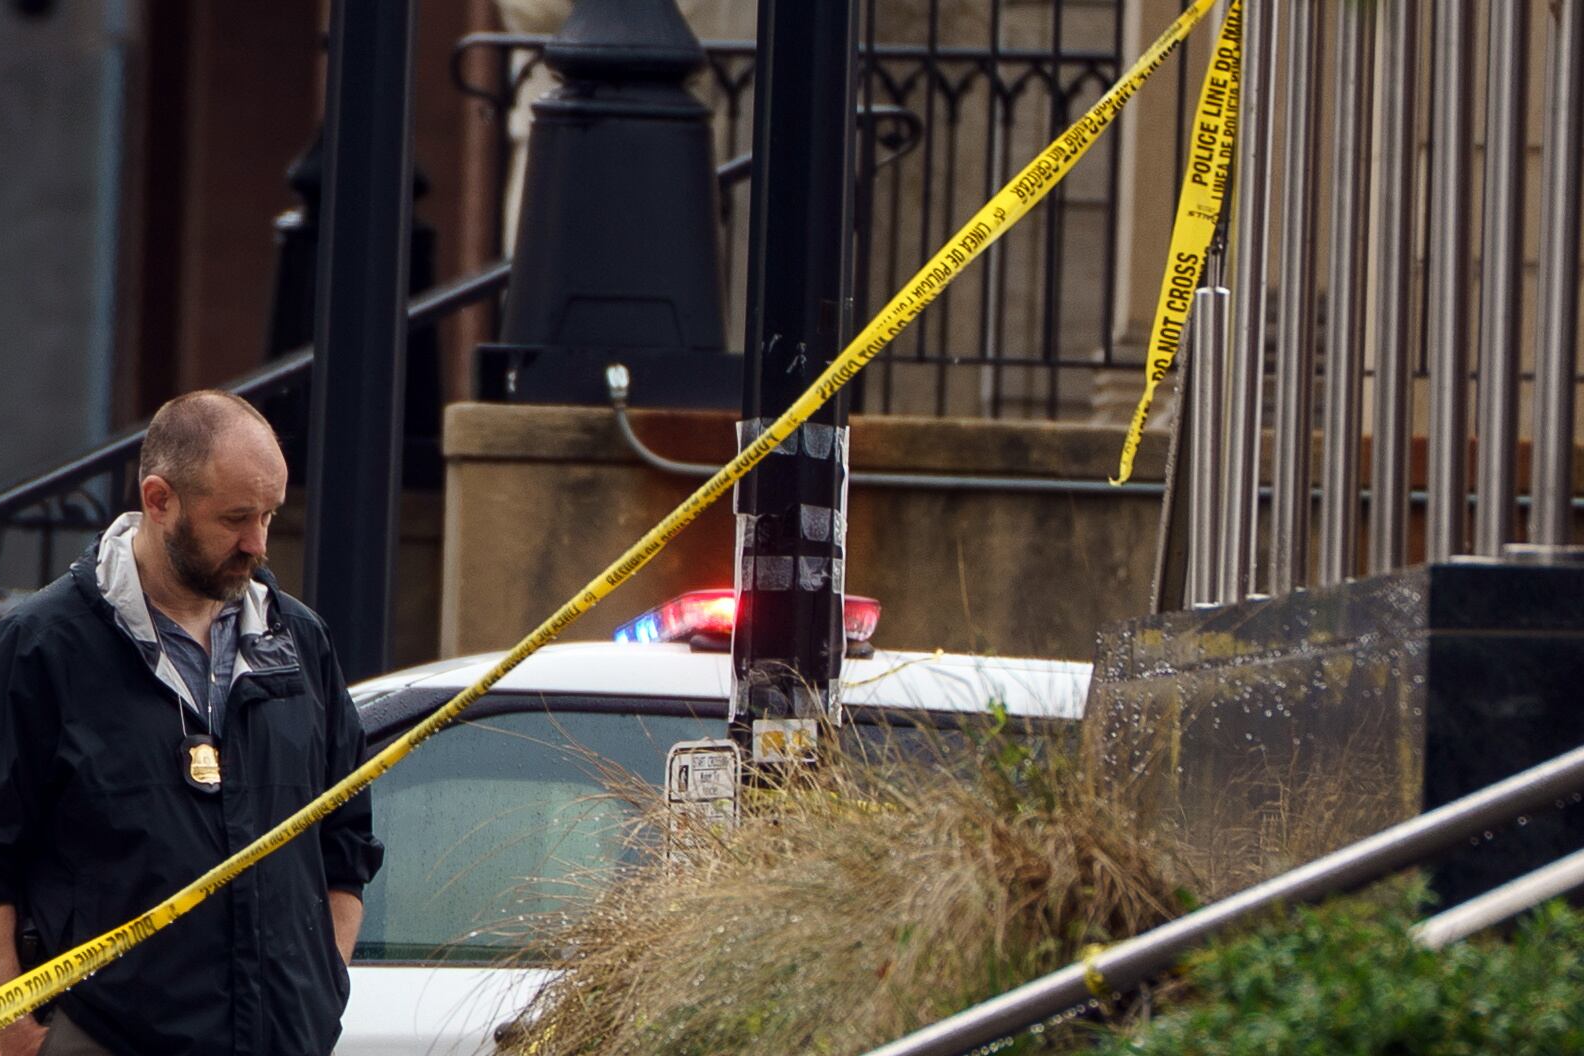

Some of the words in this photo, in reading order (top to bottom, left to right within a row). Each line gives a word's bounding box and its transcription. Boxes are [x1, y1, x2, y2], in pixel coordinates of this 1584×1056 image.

[1212, 46, 1234, 73] DO
[1200, 75, 1229, 118] LINE
[1222, 84, 1241, 139] POLICIA
[1189, 120, 1220, 186] POLICE
[1217, 140, 1233, 159] DE
[1011, 158, 1053, 200] CRUZAR
[945, 246, 966, 267] DE
[958, 219, 992, 254] LINEA
[1166, 248, 1200, 315] CROSS
[1155, 314, 1185, 356] NOT
[1149, 356, 1170, 385] DO
